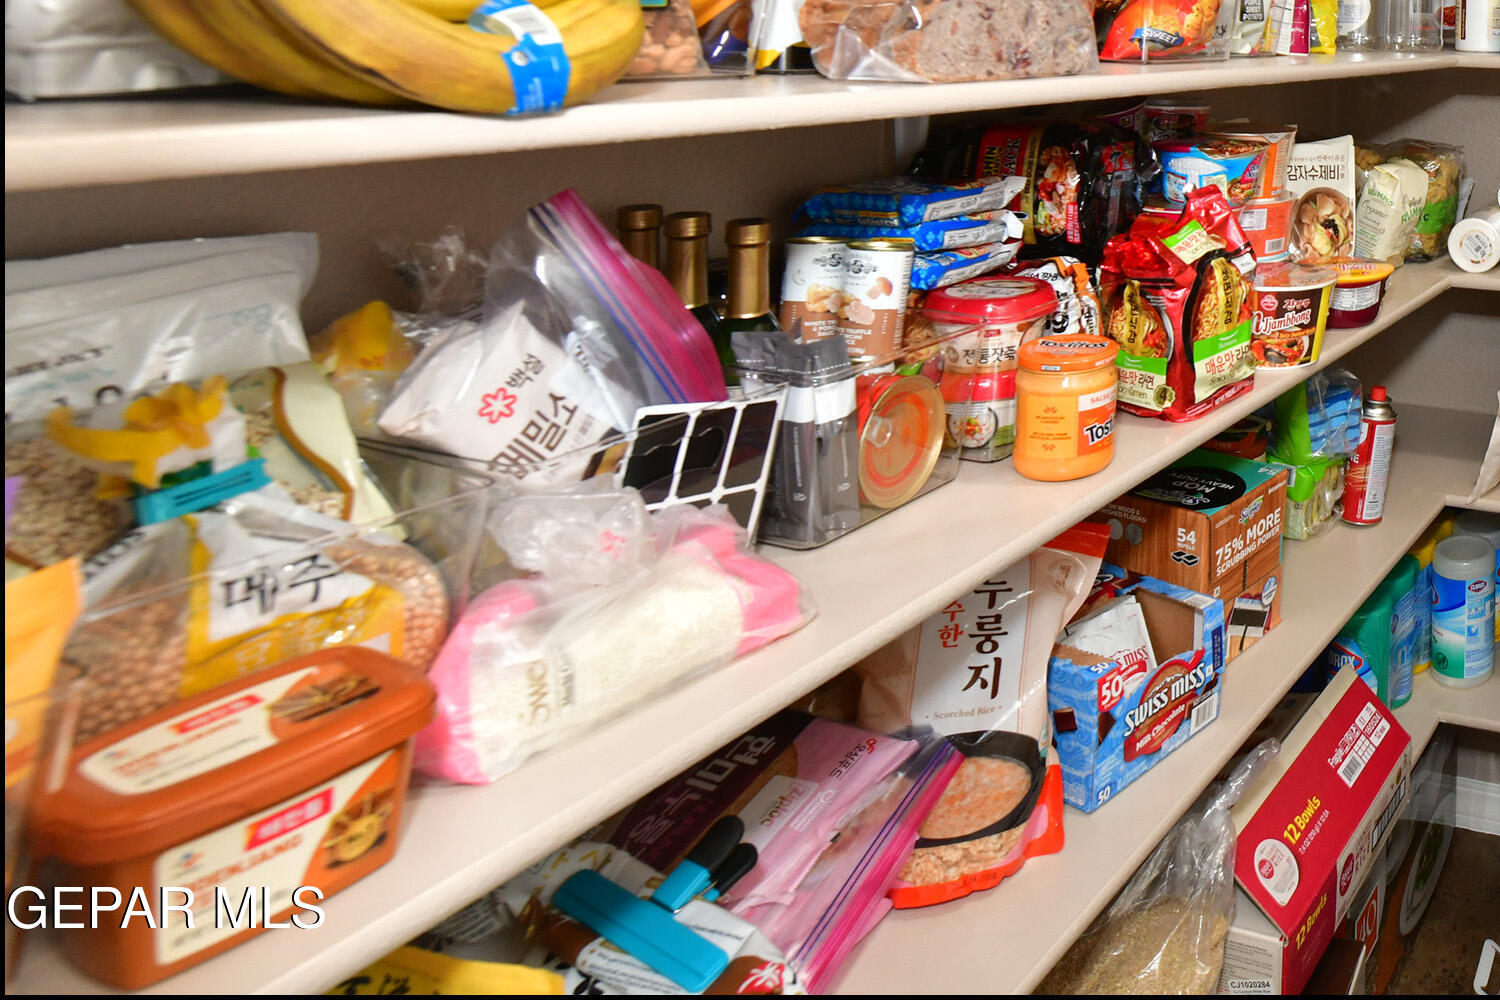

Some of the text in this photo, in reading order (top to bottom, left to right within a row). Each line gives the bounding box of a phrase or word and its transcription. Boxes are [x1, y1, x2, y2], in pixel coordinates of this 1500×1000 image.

[1176, 528, 1196, 543] 54
[1215, 508, 1282, 566] 75% MORE
[1216, 541, 1256, 577] SCRUBBING
[1101, 676, 1123, 706] 50
[1124, 663, 1206, 738] SWISS MISS
[933, 706, 996, 720] Scorched Rice
[1135, 705, 1186, 752] Milk Chocolate
[1328, 745, 1345, 769] Fragile
[1097, 785, 1111, 805] 50
[1283, 795, 1322, 845] 12 Bowls
[1295, 893, 1328, 950] 12 Bowls
